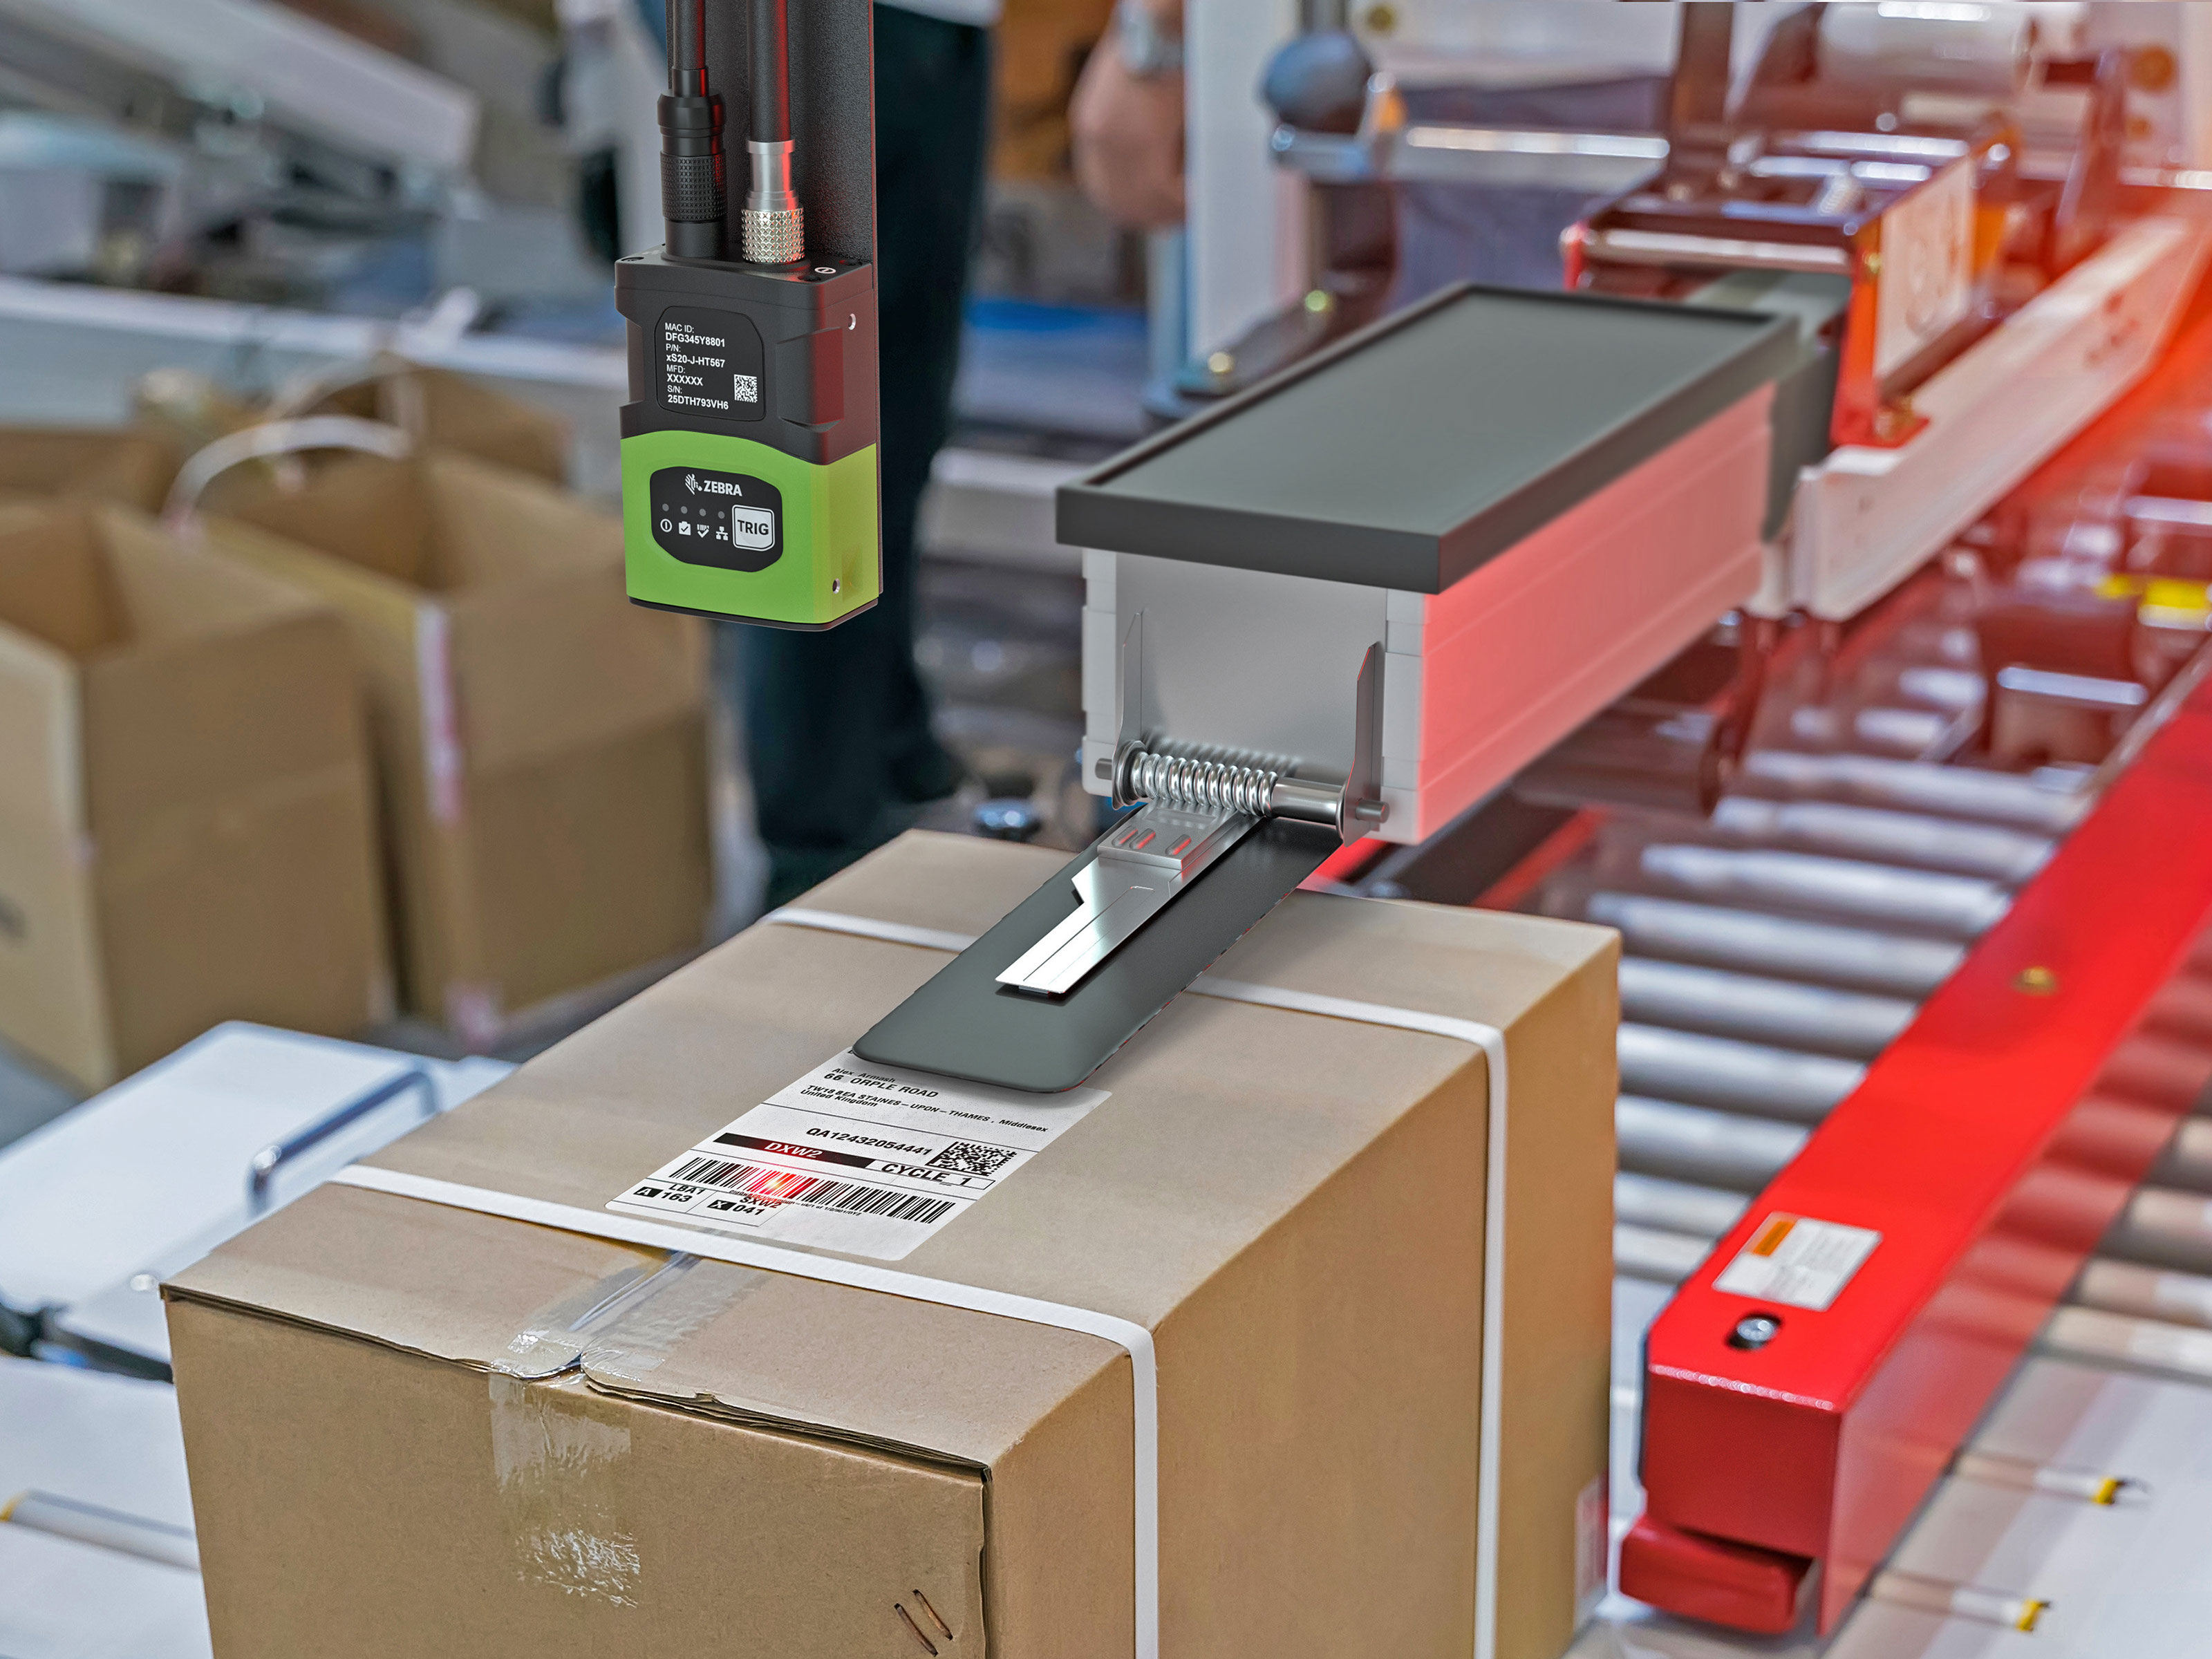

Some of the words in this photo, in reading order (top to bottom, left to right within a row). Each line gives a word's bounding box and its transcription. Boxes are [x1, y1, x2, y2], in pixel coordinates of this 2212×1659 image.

[665, 322, 682, 332] MAC
[684, 325, 694, 333] ID:
[666, 332, 725, 347] DFG345Y8801
[666, 344, 681, 352] P/N:
[666, 353, 725, 368] xS20-J-HT567
[666, 364, 686, 373] MFD:
[667, 373, 703, 386] XXXXXX
[667, 385, 682, 393] S/N:
[668, 394, 729, 409] 25DTH793VH6
[704, 480, 742, 496] ZEBRA
[738, 520, 769, 535] TRIG
[807, 1085, 834, 1094] TW18
[850, 1078, 897, 1091] ORPLE
[898, 1086, 939, 1098] ROAD
[800, 1089, 834, 1099] United
[834, 1094, 878, 1107] Kingdom
[806, 1128, 933, 1156] QA12432054441
[765, 1143, 825, 1159] DXW2
[668, 1183, 705, 1195] LBA1
[661, 1192, 693, 1202] 163
[740, 1197, 782, 1208] SXW2
[711, 1201, 727, 1209] X
[732, 1205, 765, 1215] 041
